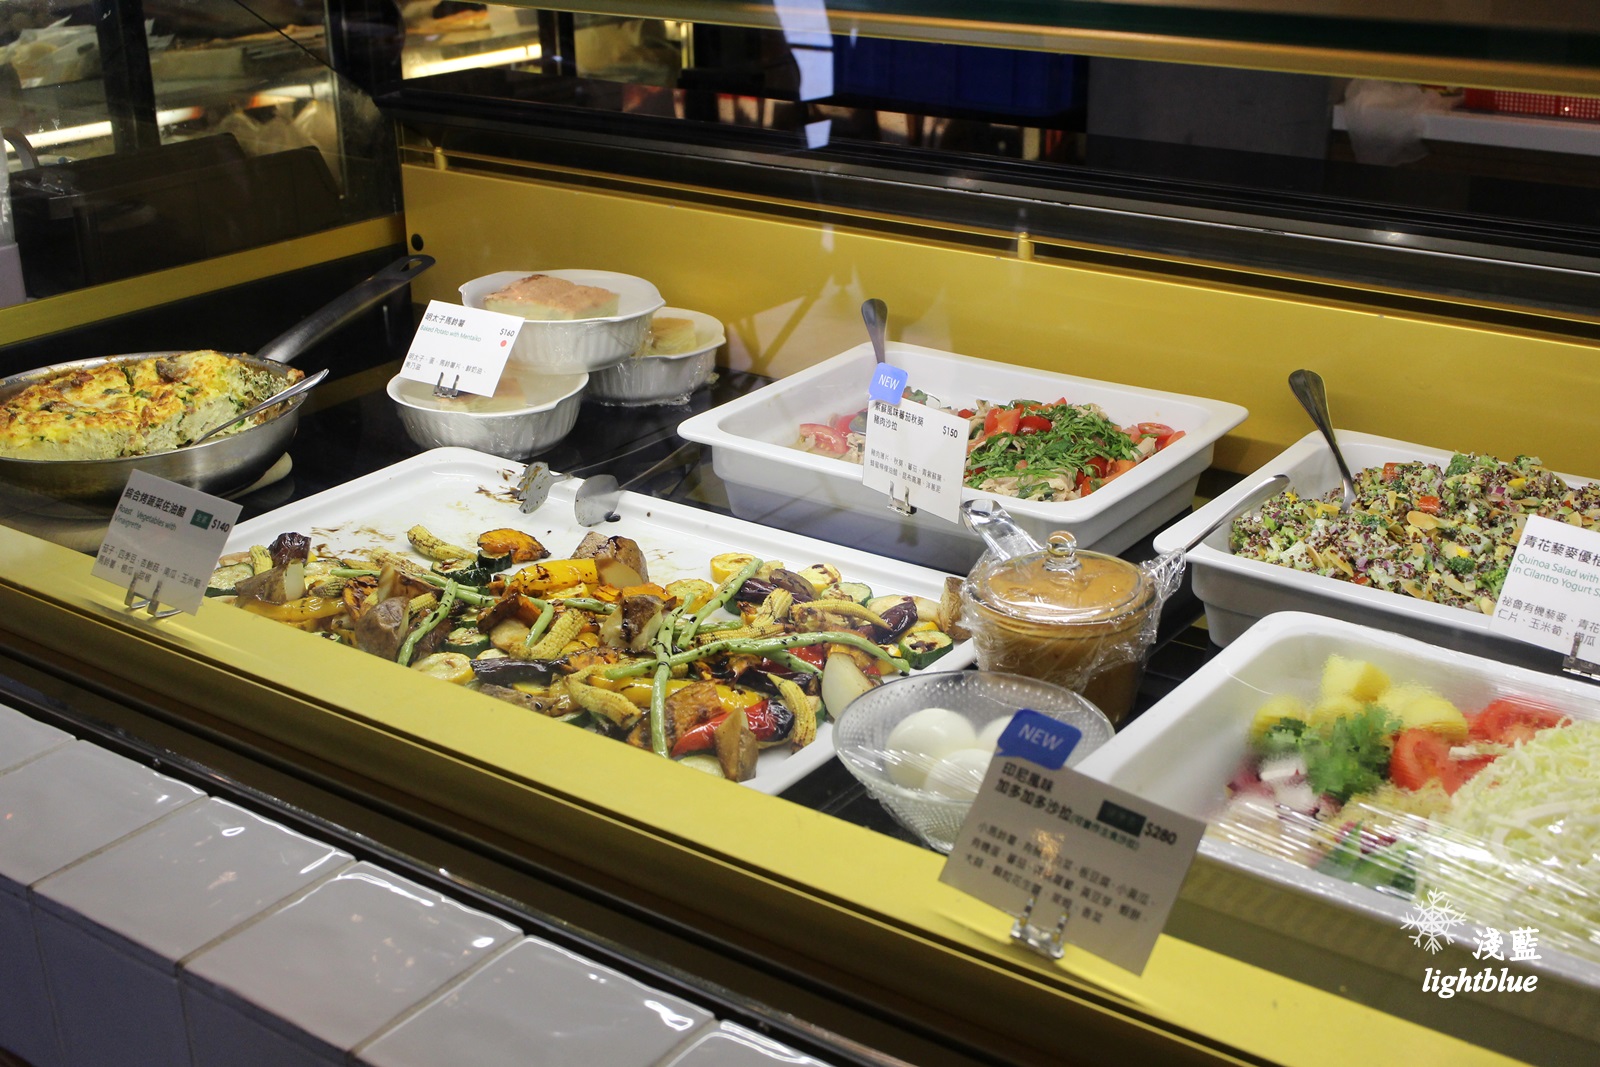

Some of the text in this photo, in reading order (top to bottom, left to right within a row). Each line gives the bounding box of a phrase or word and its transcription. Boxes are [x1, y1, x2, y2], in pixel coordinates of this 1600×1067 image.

[420, 324, 434, 334] Baked
[434, 327, 449, 337] Potato
[449, 330, 460, 338] with
[424, 312, 466, 328] 明太子馬鈴薯
[878, 373, 901, 391] NEW
[873, 414, 898, 432] 豬肉沙拉
[942, 426, 959, 439] $150
[119, 503, 178, 532] Roast Vegetables with
[123, 486, 188, 519] 綜合烤蔬菜佐油醋
[211, 519, 230, 533] $140
[114, 514, 142, 532] Vinaigrette
[1512, 564, 1522, 574] in
[1523, 566, 1559, 585] Cilantro
[1560, 578, 1592, 595] Yogurt
[1517, 553, 1599, 584] Quinoa Salad with
[1017, 723, 1066, 752] NEW
[1001, 761, 1055, 793] 印尼風味
[1144, 822, 1178, 845] $280
